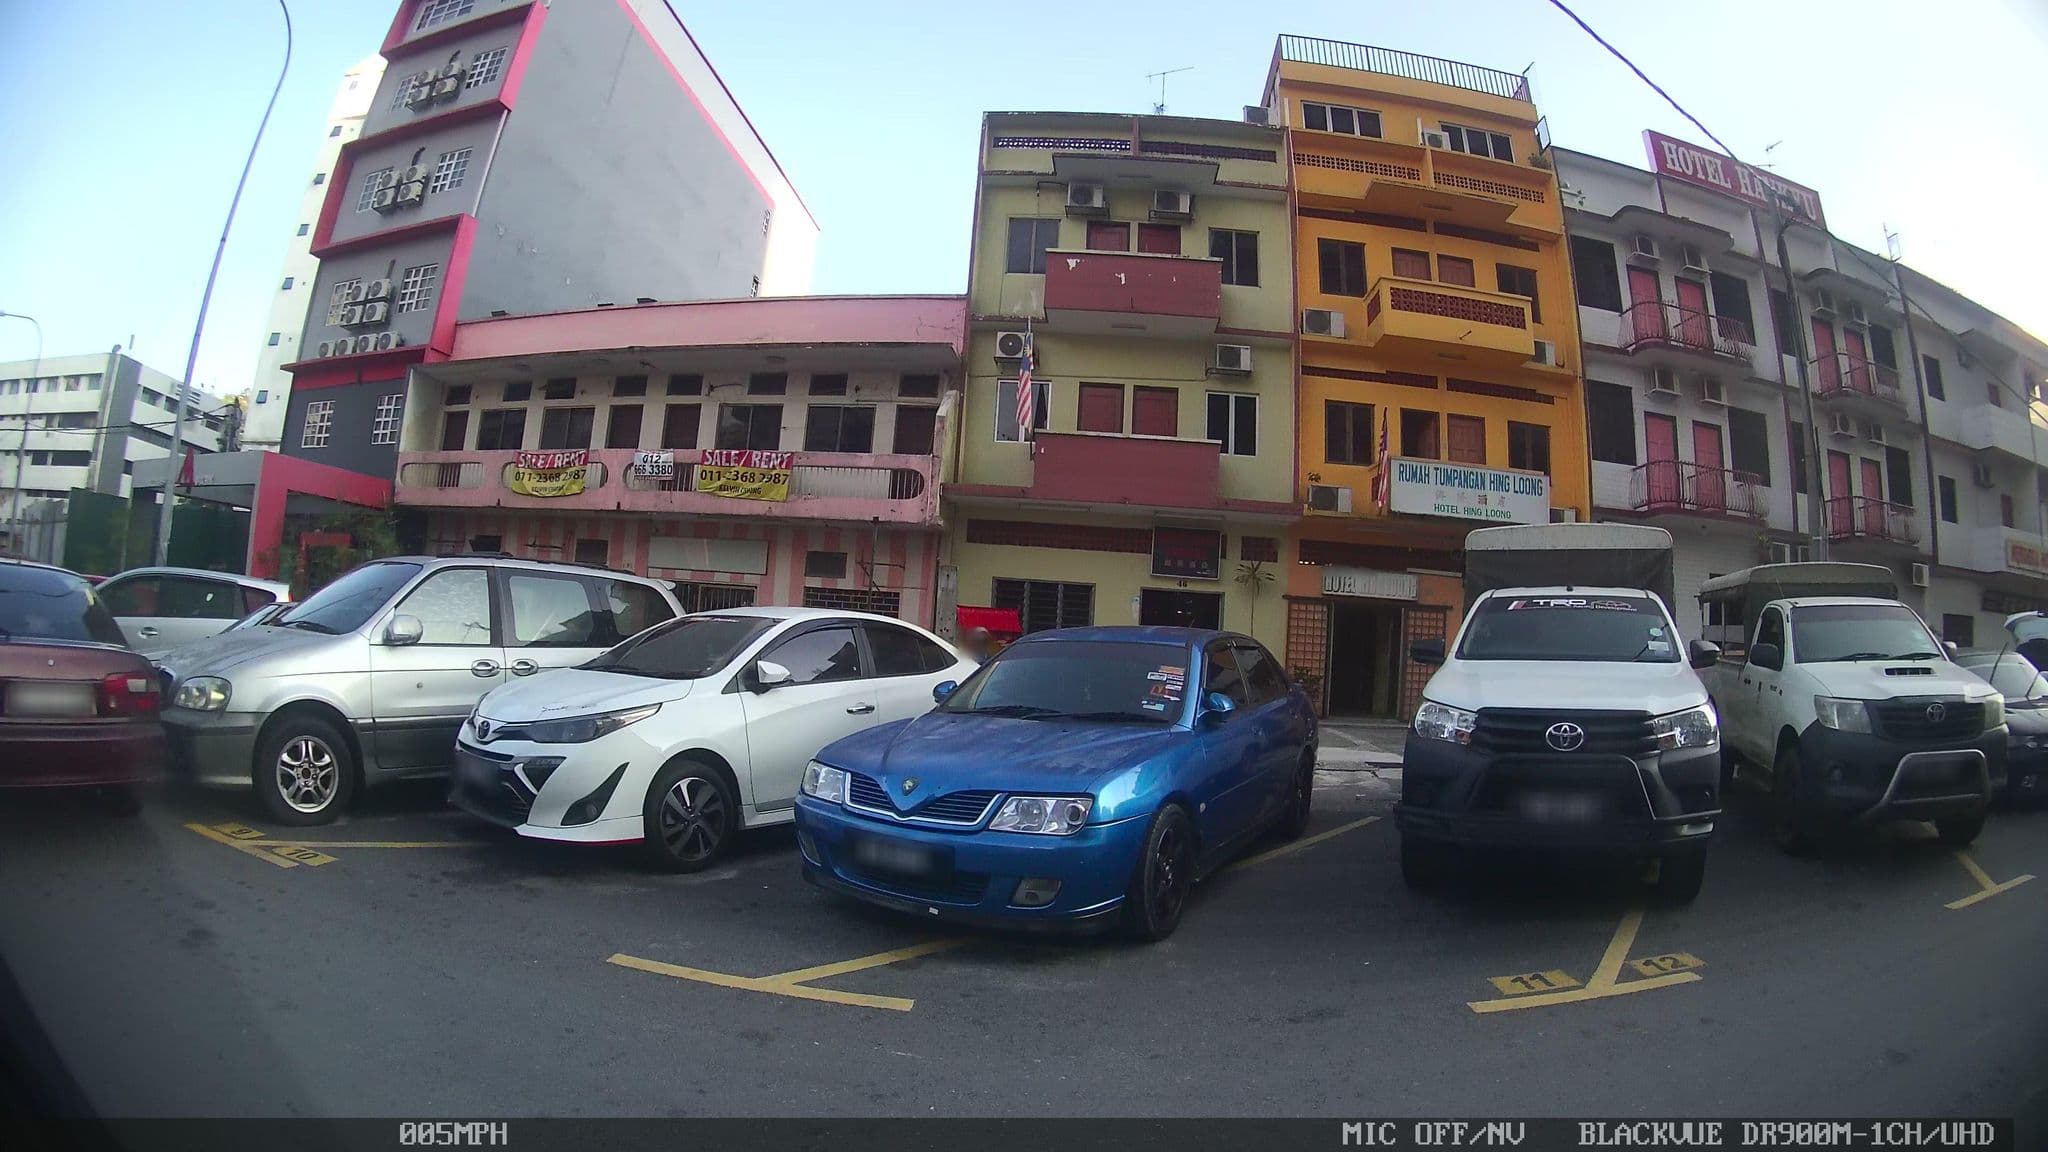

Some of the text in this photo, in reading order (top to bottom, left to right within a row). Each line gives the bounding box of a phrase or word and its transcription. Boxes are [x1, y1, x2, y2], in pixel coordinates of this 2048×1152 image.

[1660, 140, 1732, 190] HOTEL
[518, 450, 586, 468] SALE/RENT
[642, 454, 662, 464] 012
[704, 449, 791, 469] SALE/RENT
[648, 464, 673, 475] 3380
[1398, 463, 1543, 497] RUMAH TUMPANGAN HING LOONG
[1433, 503, 1512, 519] HOTEL HING LOONG
[286, 848, 320, 860] 10
[1642, 956, 1688, 971] 12
[1510, 973, 1556, 990] 11
